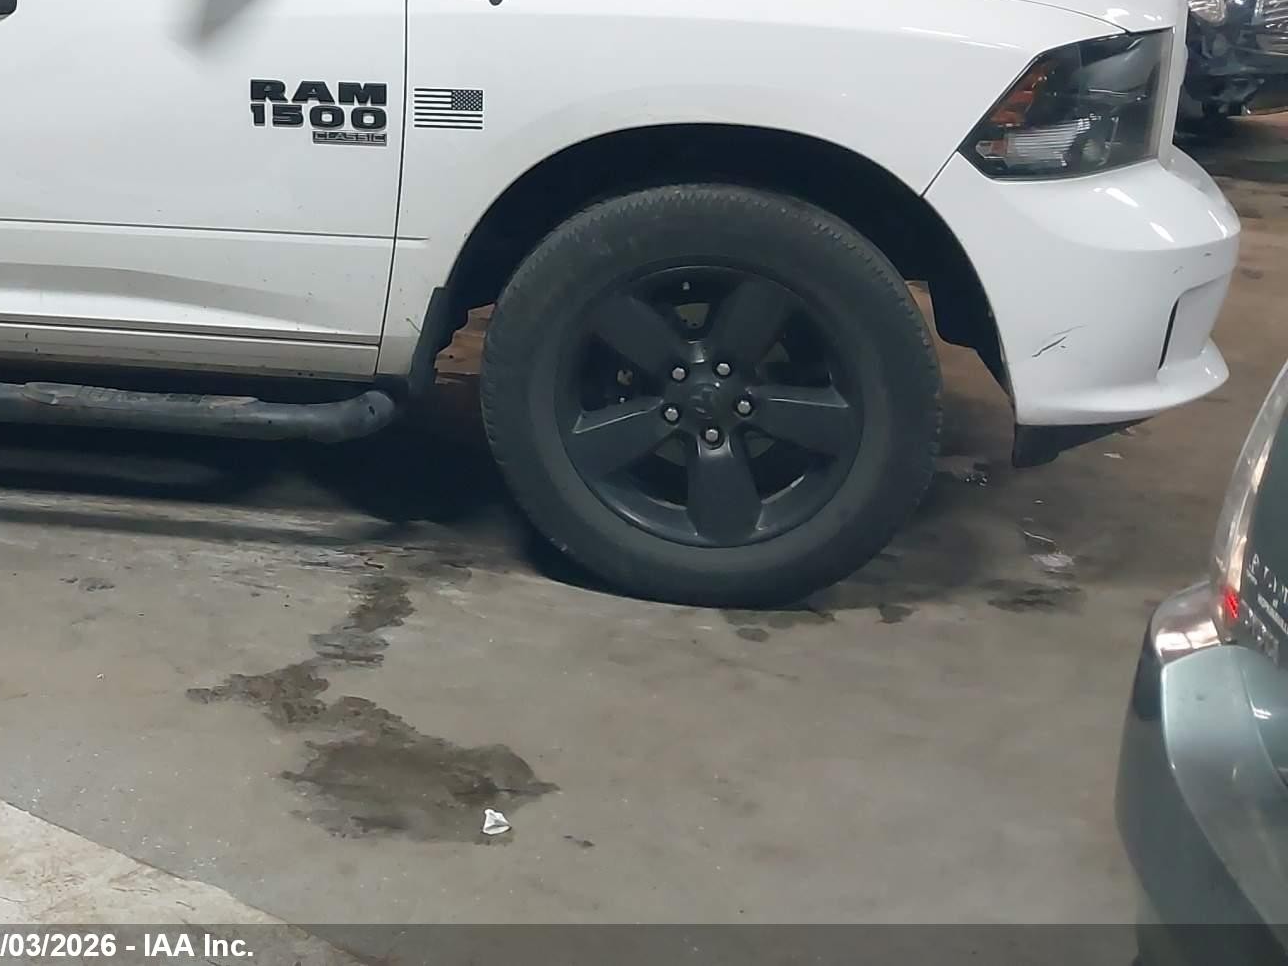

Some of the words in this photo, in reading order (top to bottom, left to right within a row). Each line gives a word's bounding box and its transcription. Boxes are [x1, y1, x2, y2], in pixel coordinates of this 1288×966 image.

[250, 79, 387, 106] RAM
[250, 103, 387, 130] 1500
[314, 131, 386, 143] CLASSIC
